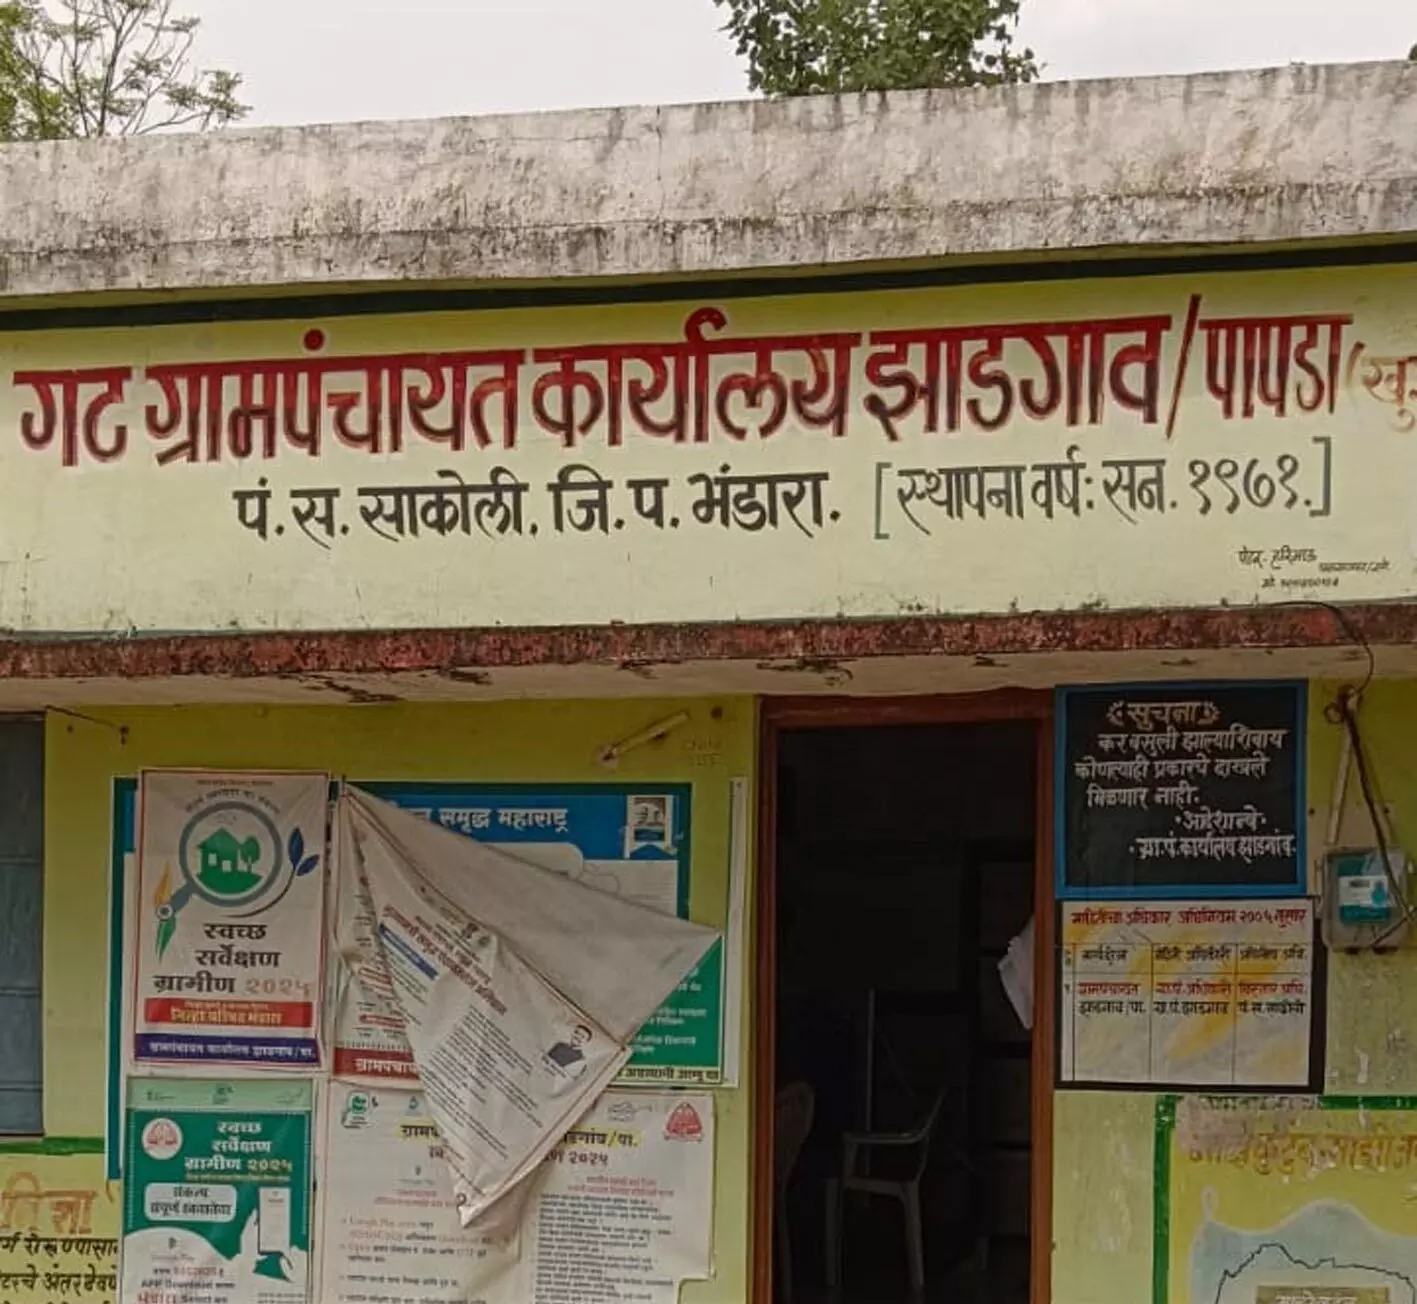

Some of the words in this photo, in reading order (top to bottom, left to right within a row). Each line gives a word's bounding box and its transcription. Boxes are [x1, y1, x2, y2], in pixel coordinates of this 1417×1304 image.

[13, 367, 132, 466] गट
[145, 328, 526, 465] ग्रामपंचायत
[532, 307, 861, 447] कार्यालय
[688, 463, 840, 538] भंडारा.
[1098, 733, 1128, 754] कर
[440, 807, 491, 832] समृद्ध
[498, 807, 568, 833] महाराष्ट्र
[204, 923, 268, 941] स्वच्छ
[195, 944, 282, 967] सर्वेक्षण
[153, 972, 235, 993] ग्रामीण
